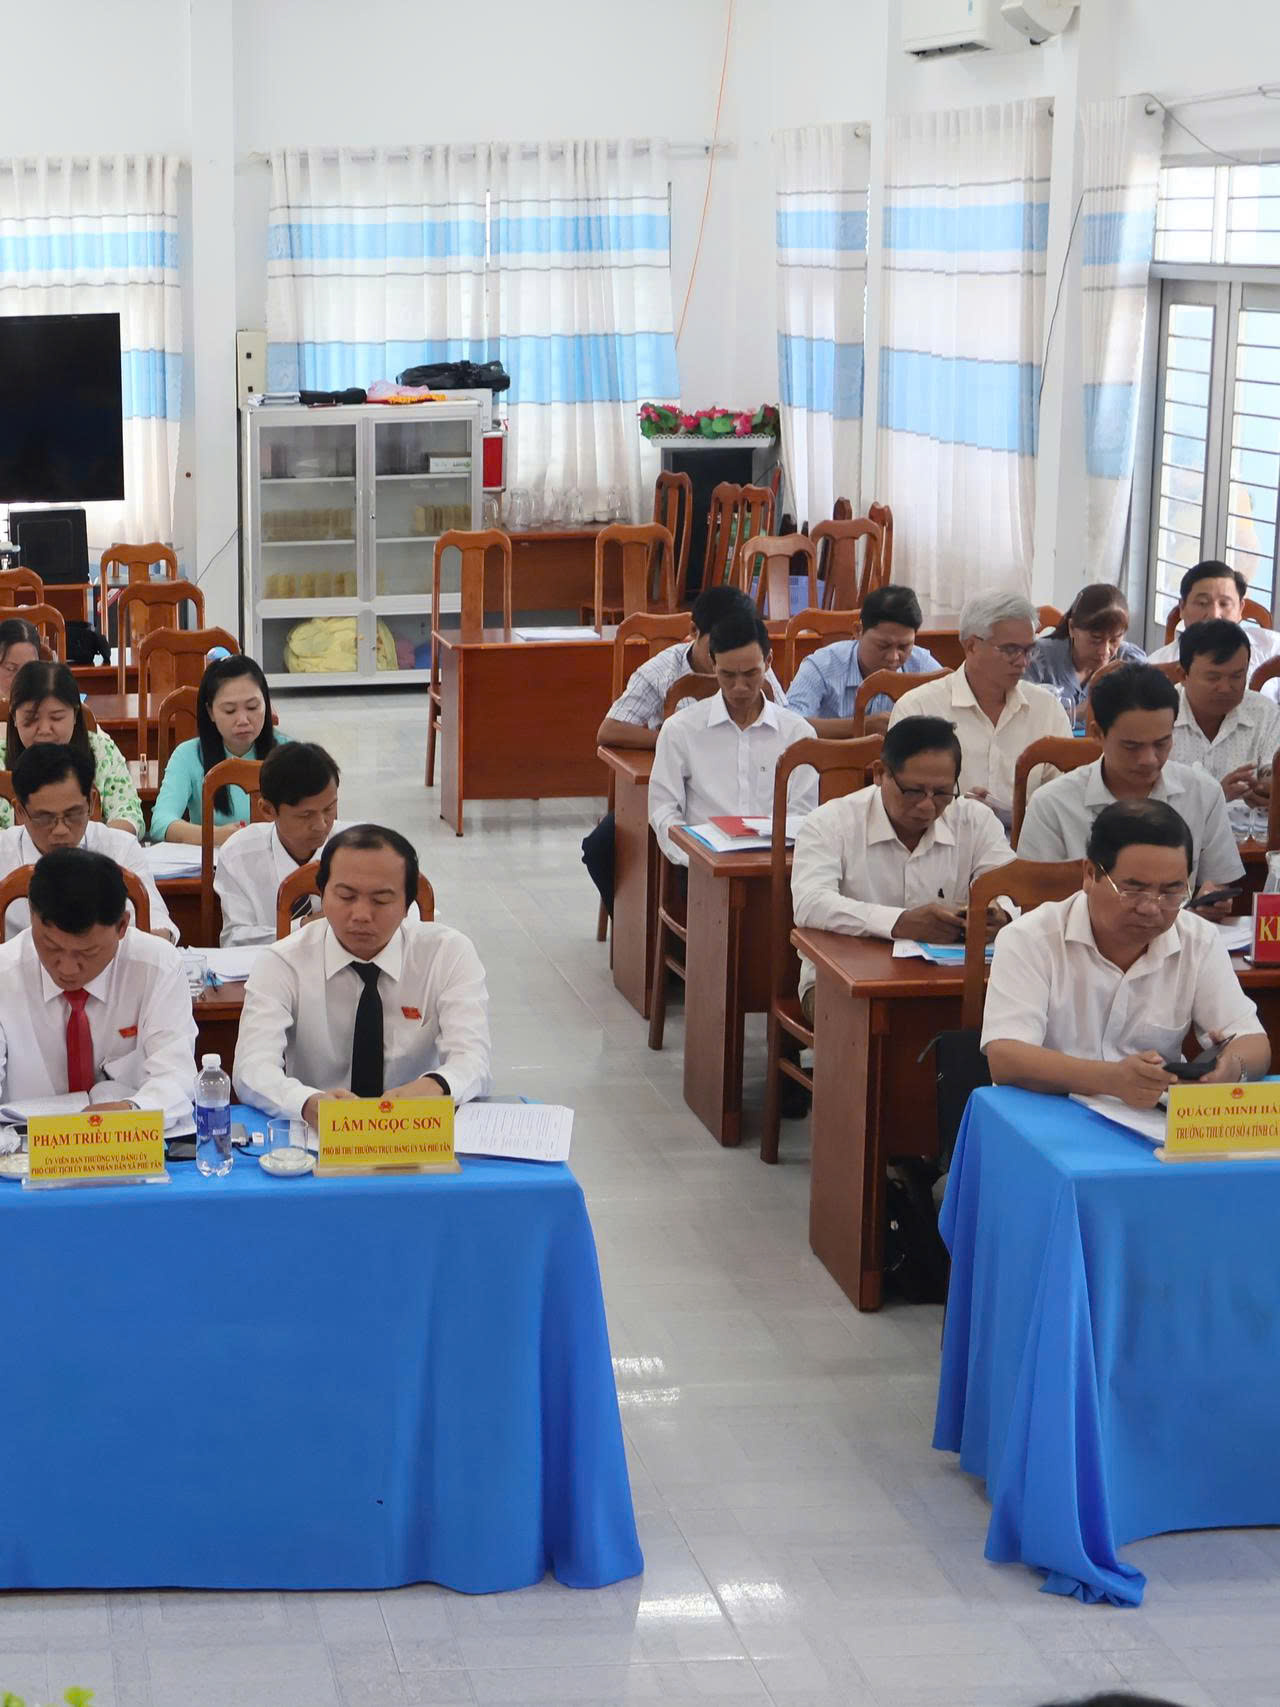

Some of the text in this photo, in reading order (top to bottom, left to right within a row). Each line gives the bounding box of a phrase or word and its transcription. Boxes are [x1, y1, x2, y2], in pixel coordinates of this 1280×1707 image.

[1177, 1105, 1221, 1118] QUÁCH
[1224, 1105, 1257, 1116] MINH
[332, 1116, 441, 1133] LÂM NGỌC SƠN
[33, 1133, 70, 1149] PHẠM
